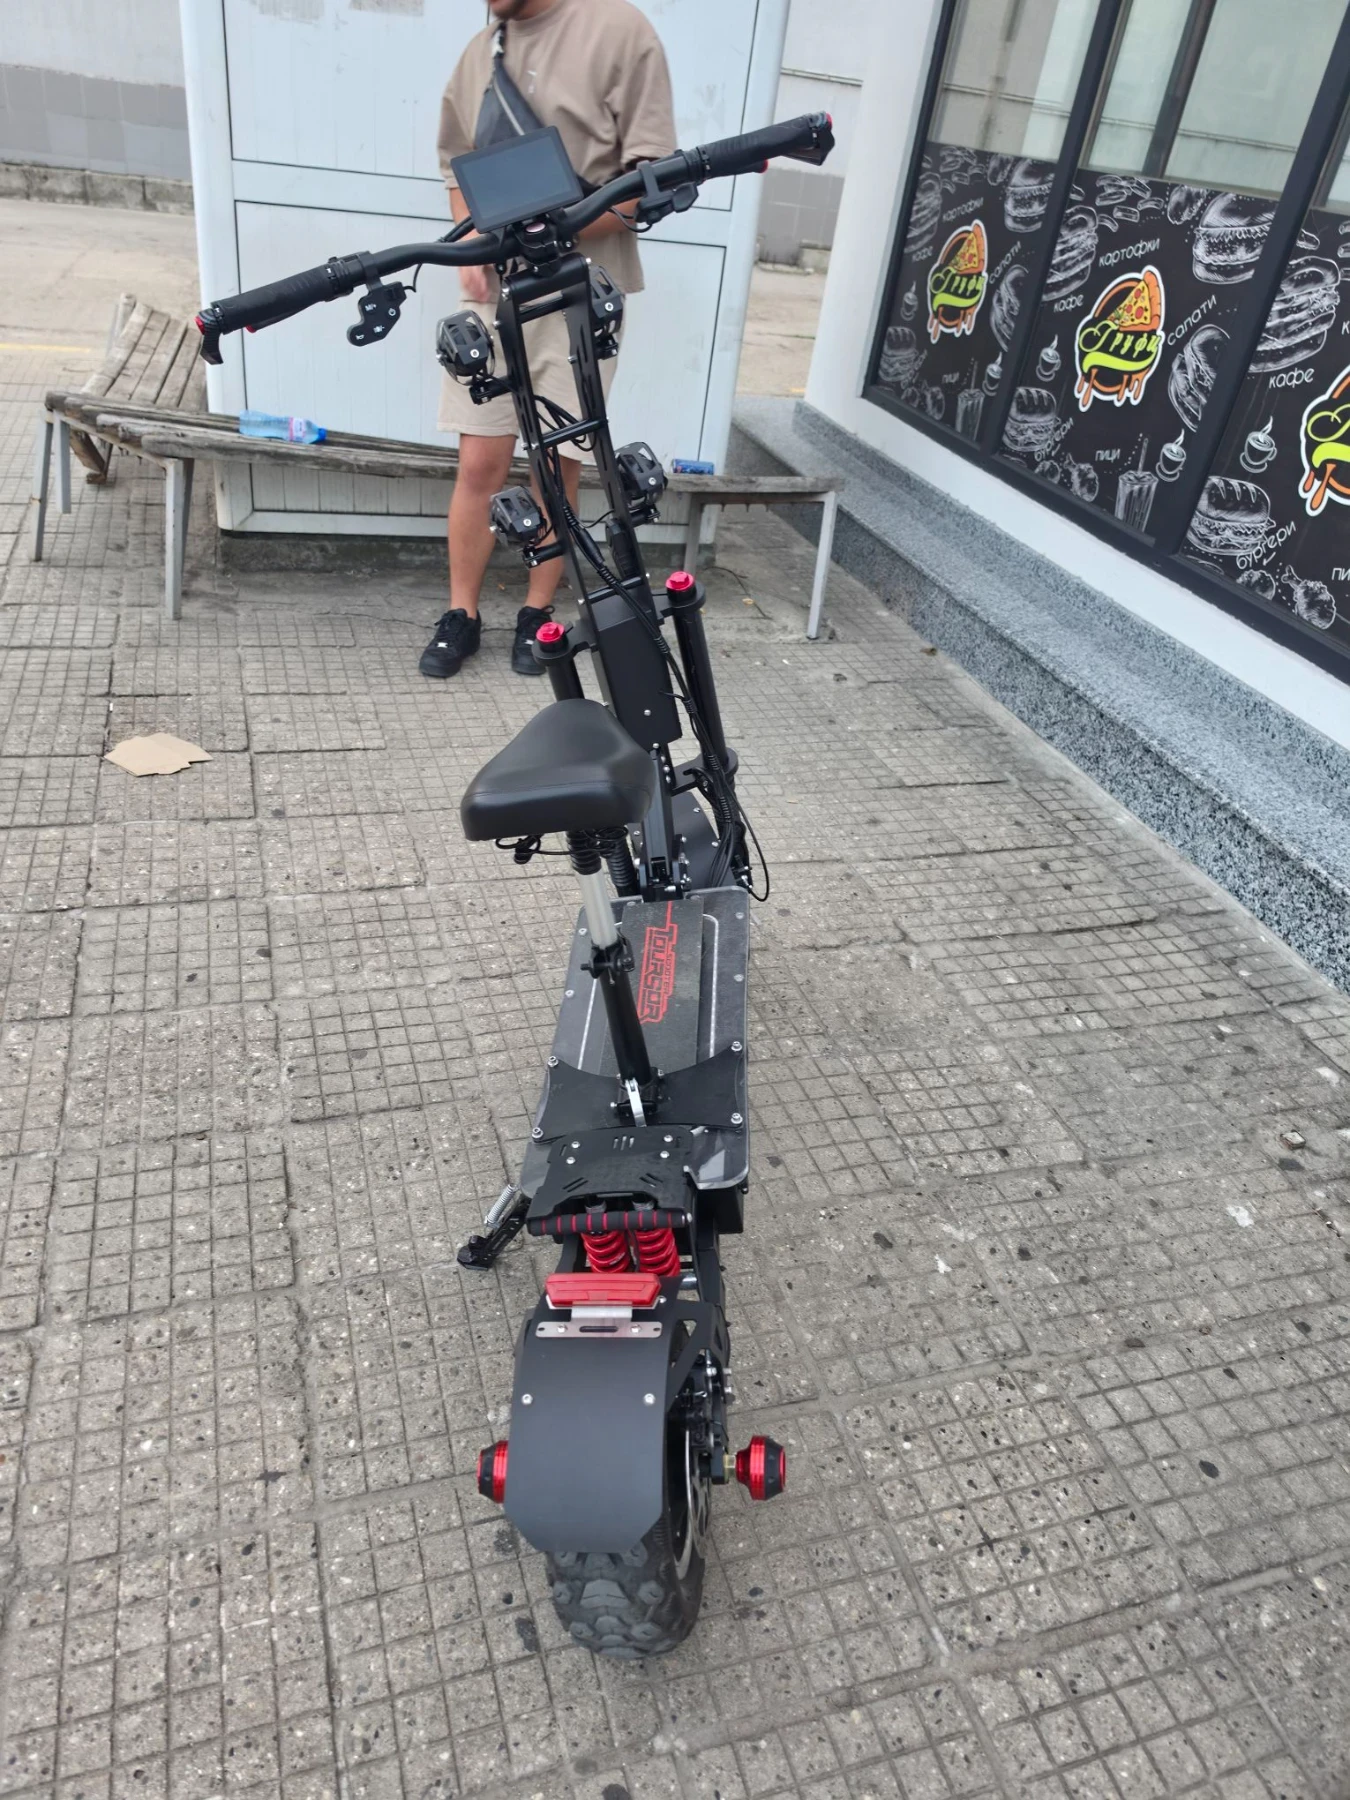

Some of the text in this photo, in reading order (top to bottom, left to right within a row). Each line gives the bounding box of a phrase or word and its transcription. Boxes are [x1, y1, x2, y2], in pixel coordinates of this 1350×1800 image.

[1099, 237, 1160, 267] картофки
[1053, 293, 1084, 312] кафе
[1268, 367, 1314, 389] кафе
[1095, 448, 1120, 463] пици
[1236, 520, 1296, 570] бургери
